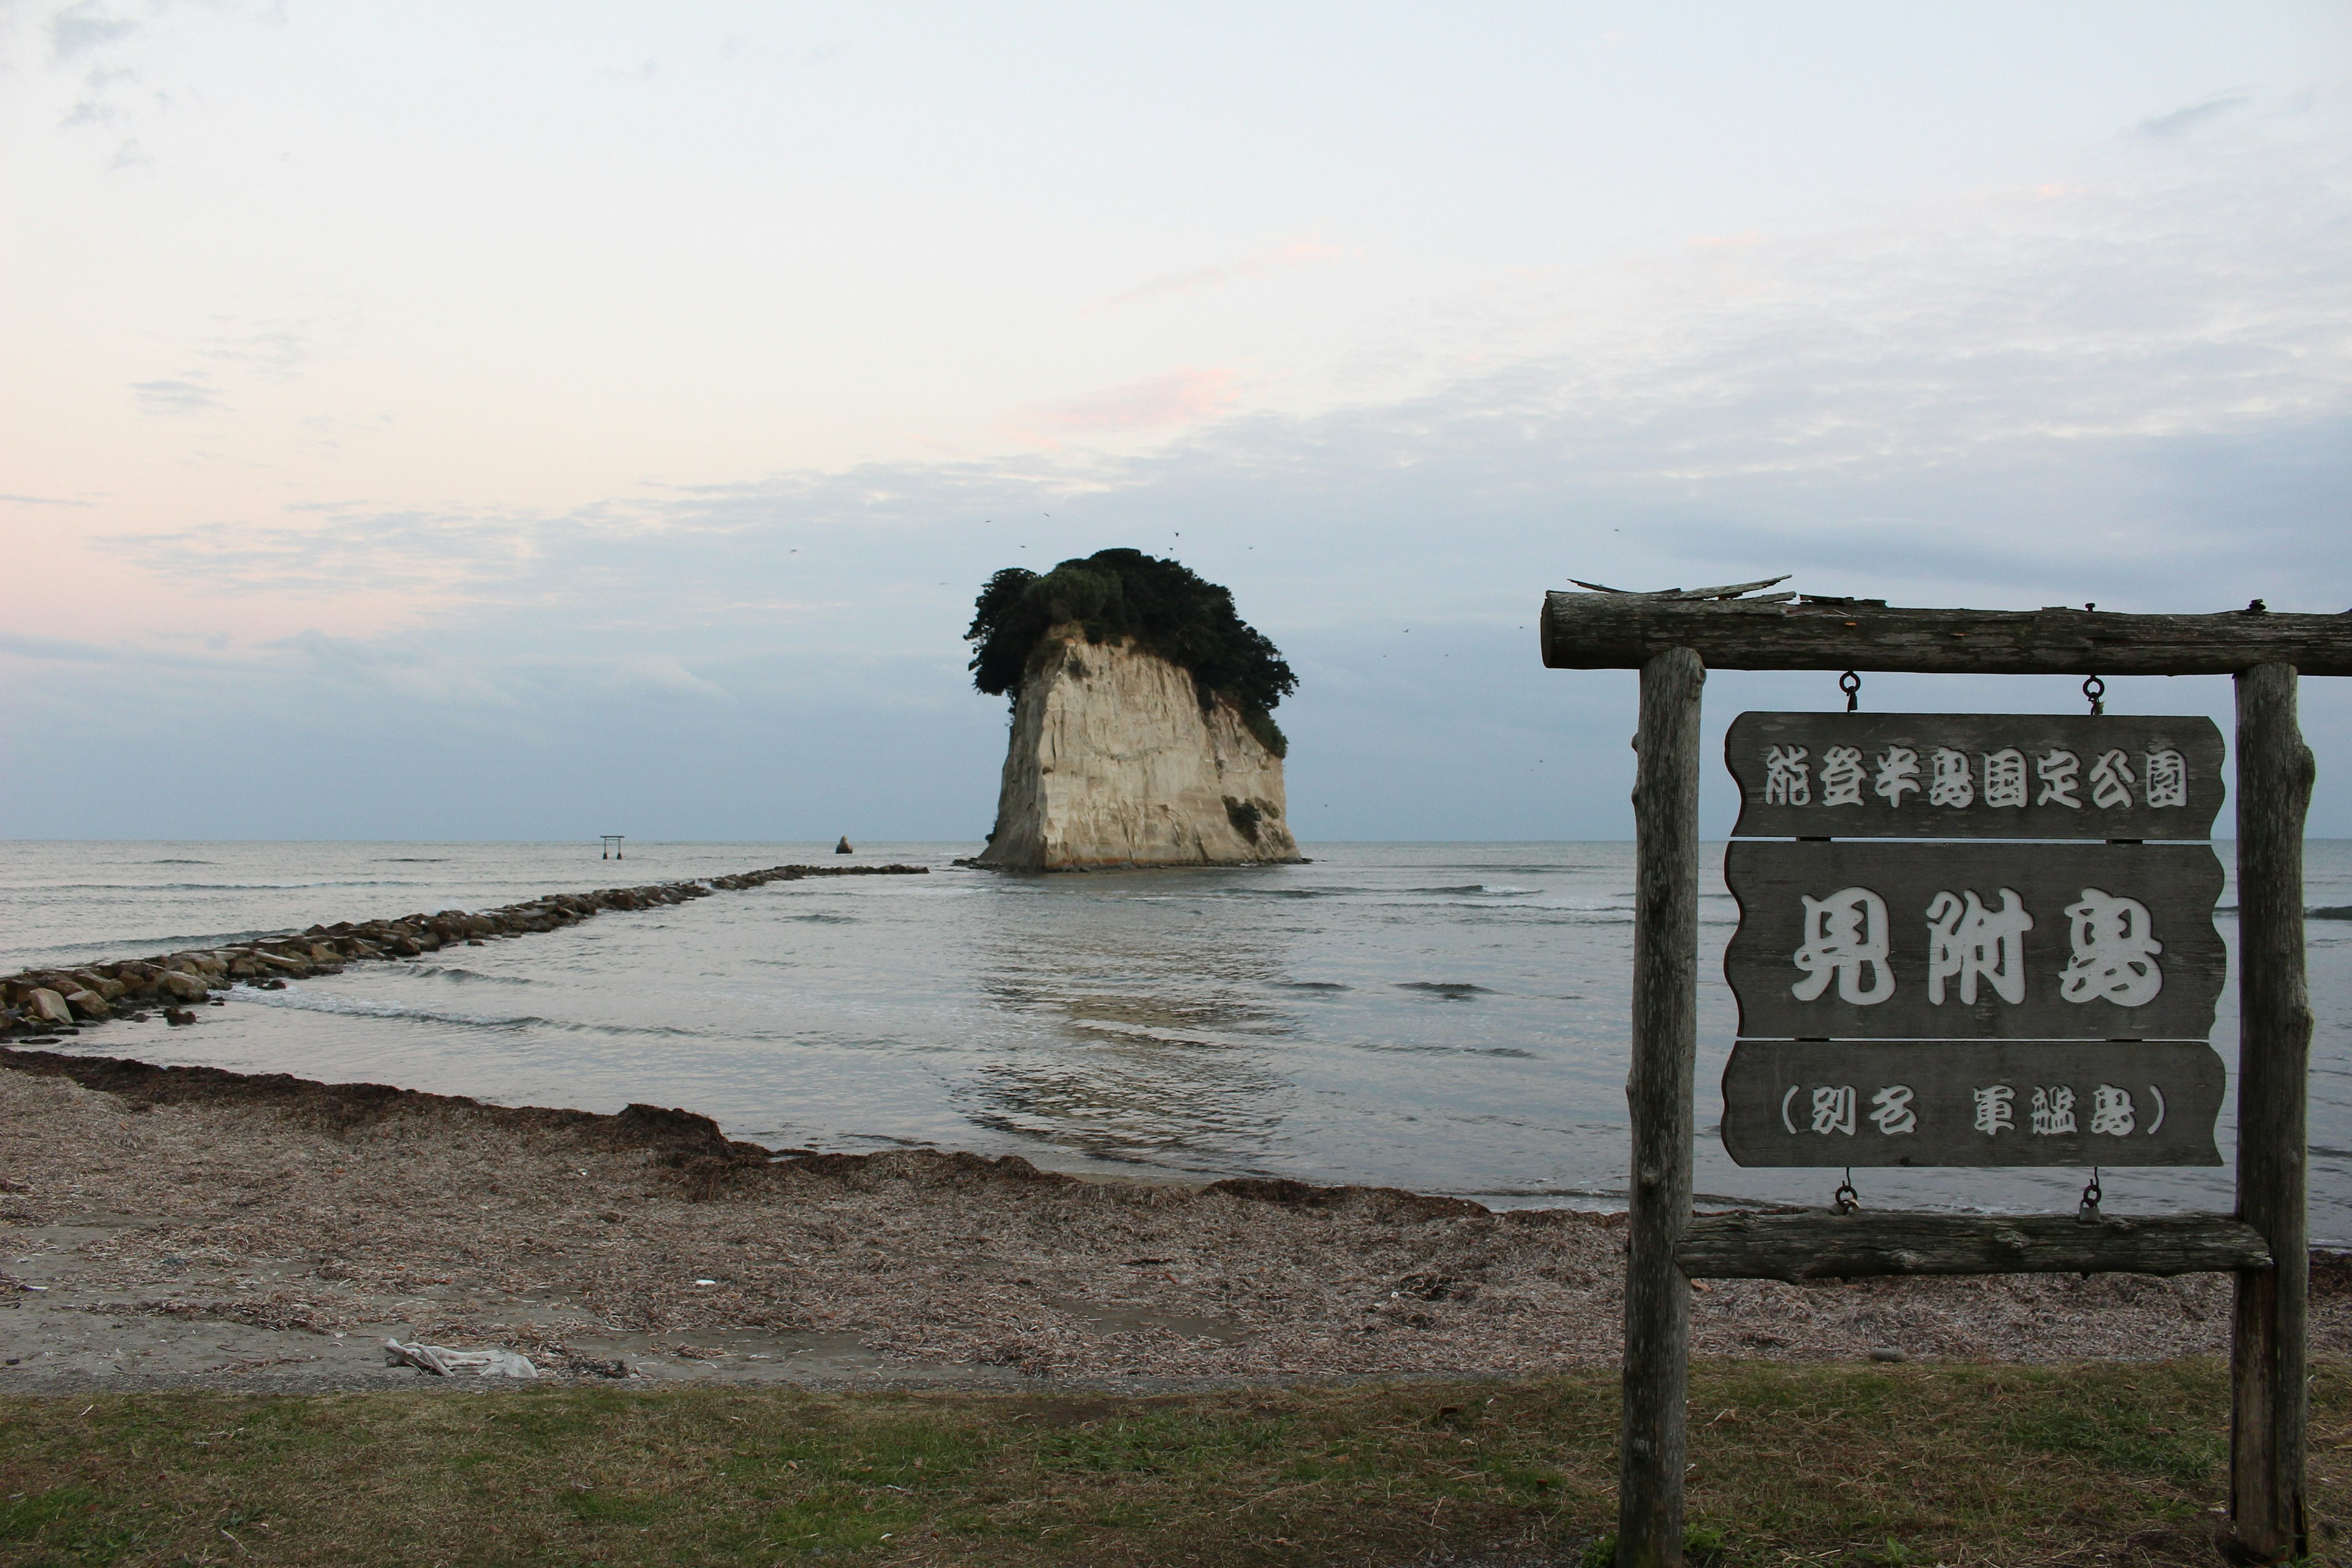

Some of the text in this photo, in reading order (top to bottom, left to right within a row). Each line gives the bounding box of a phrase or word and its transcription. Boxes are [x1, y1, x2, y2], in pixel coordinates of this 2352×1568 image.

[1764, 745, 2187, 809] 能登半島国定公園
[1791, 887, 2162, 1008] 見附島
